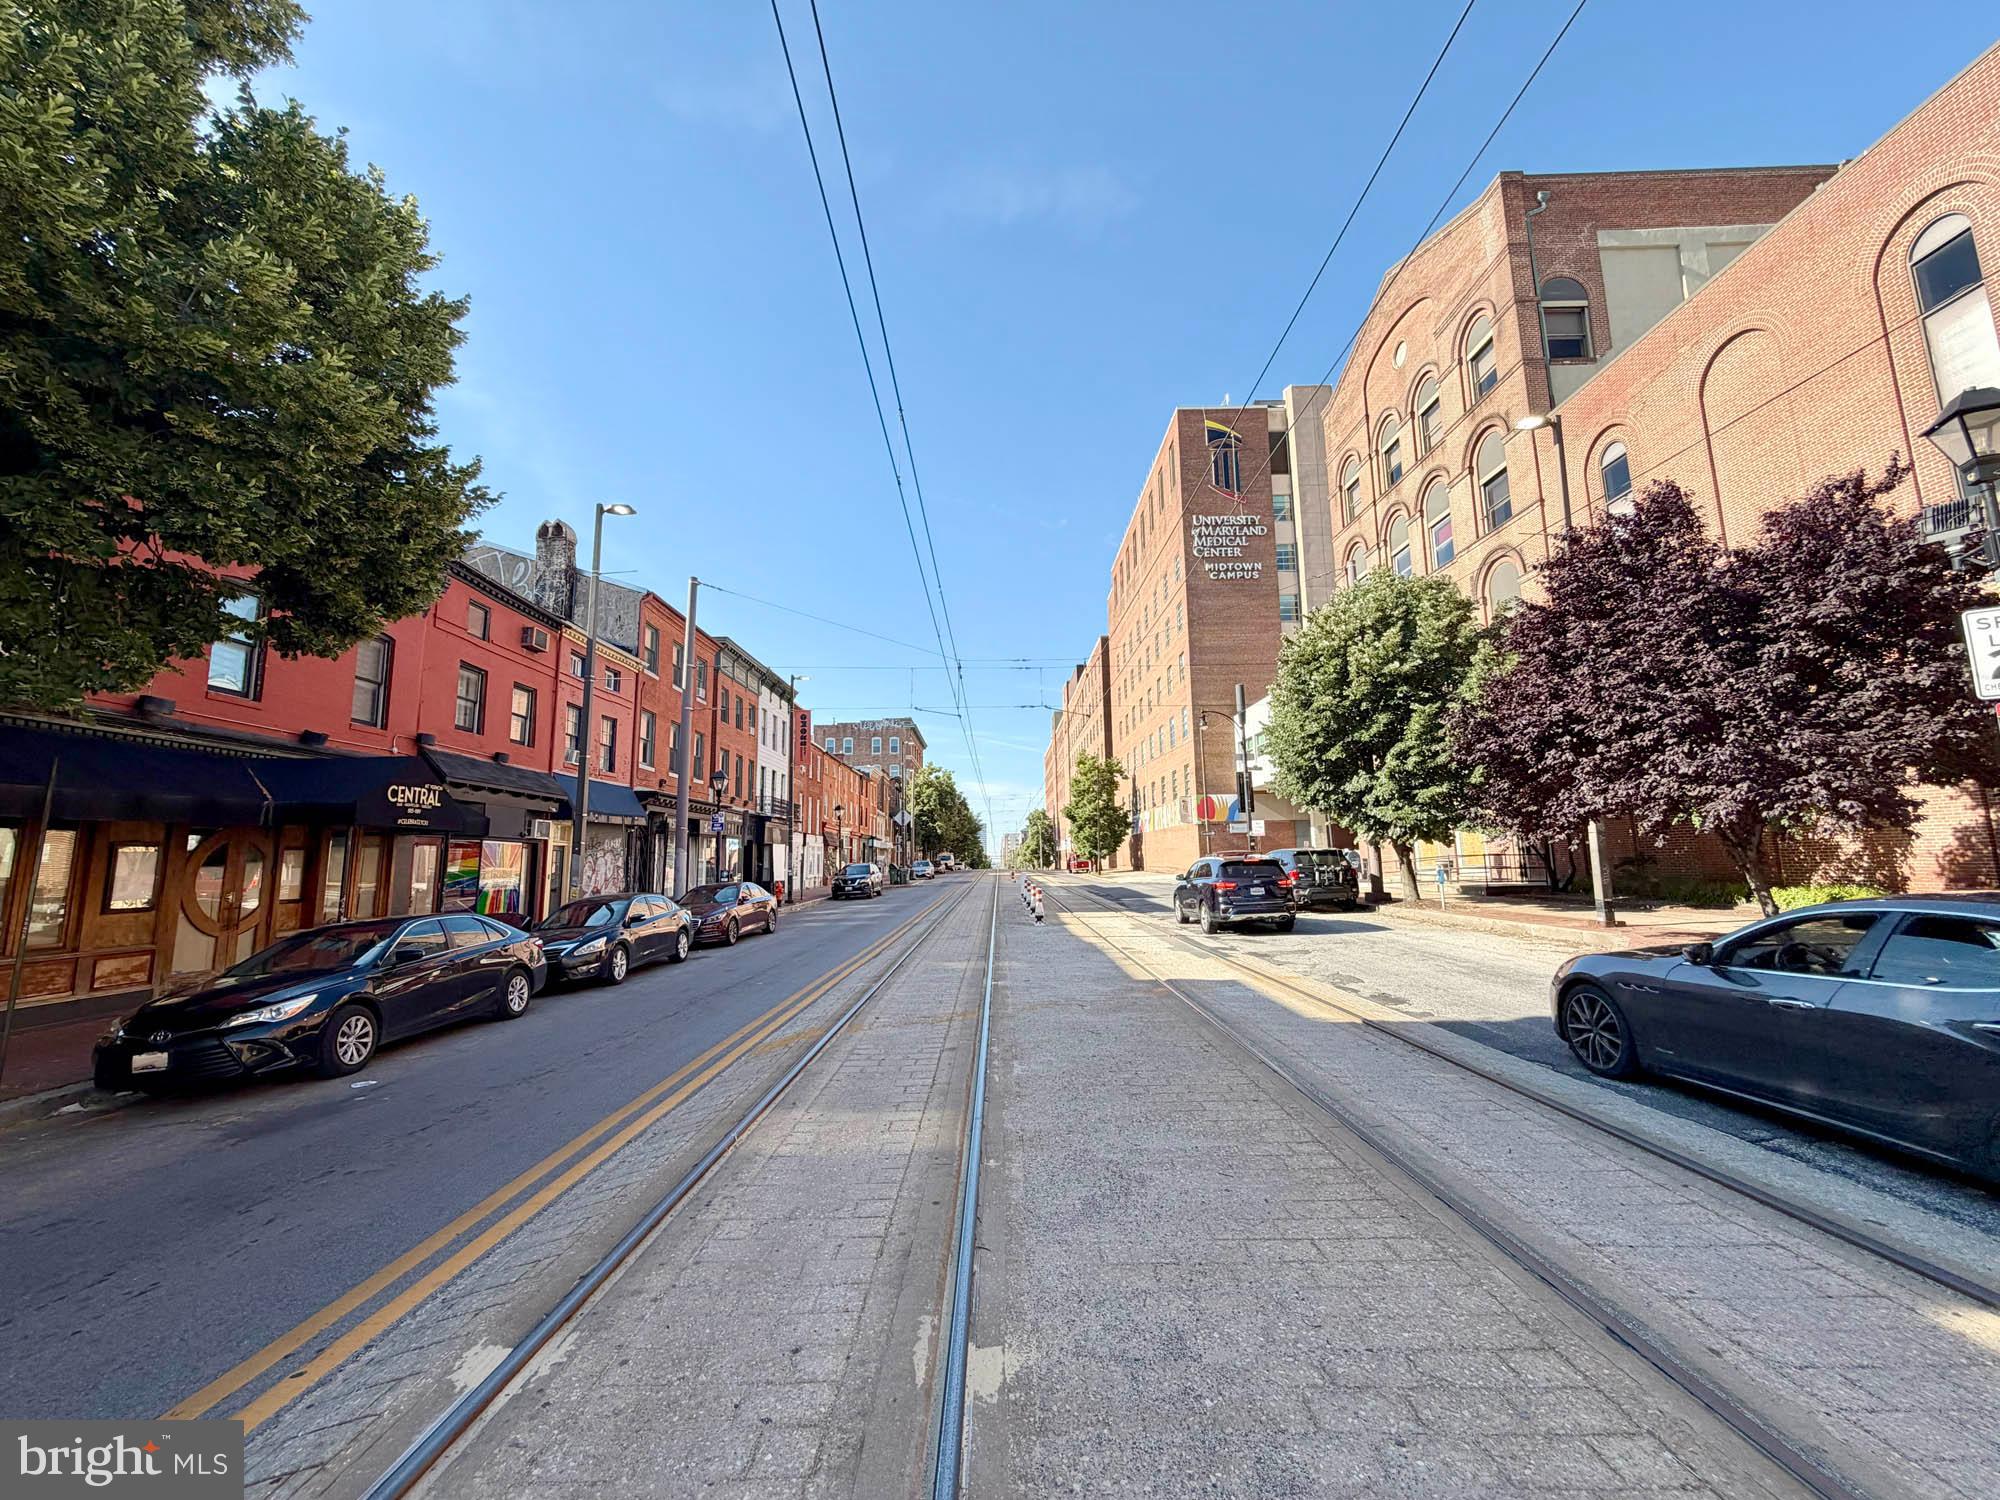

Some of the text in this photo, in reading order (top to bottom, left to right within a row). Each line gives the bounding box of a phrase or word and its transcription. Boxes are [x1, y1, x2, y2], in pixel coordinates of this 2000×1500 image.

[1192, 515, 1260, 525] UNIVERSITY
[1201, 526, 1267, 535] MARYLAND
[1194, 536, 1249, 546] MEDICAL
[1193, 546, 1243, 557] CENTER
[1205, 562, 1262, 571] MIDTOWN
[1210, 571, 1259, 579] CAMPUS
[387, 785, 441, 806] CENTRAL
